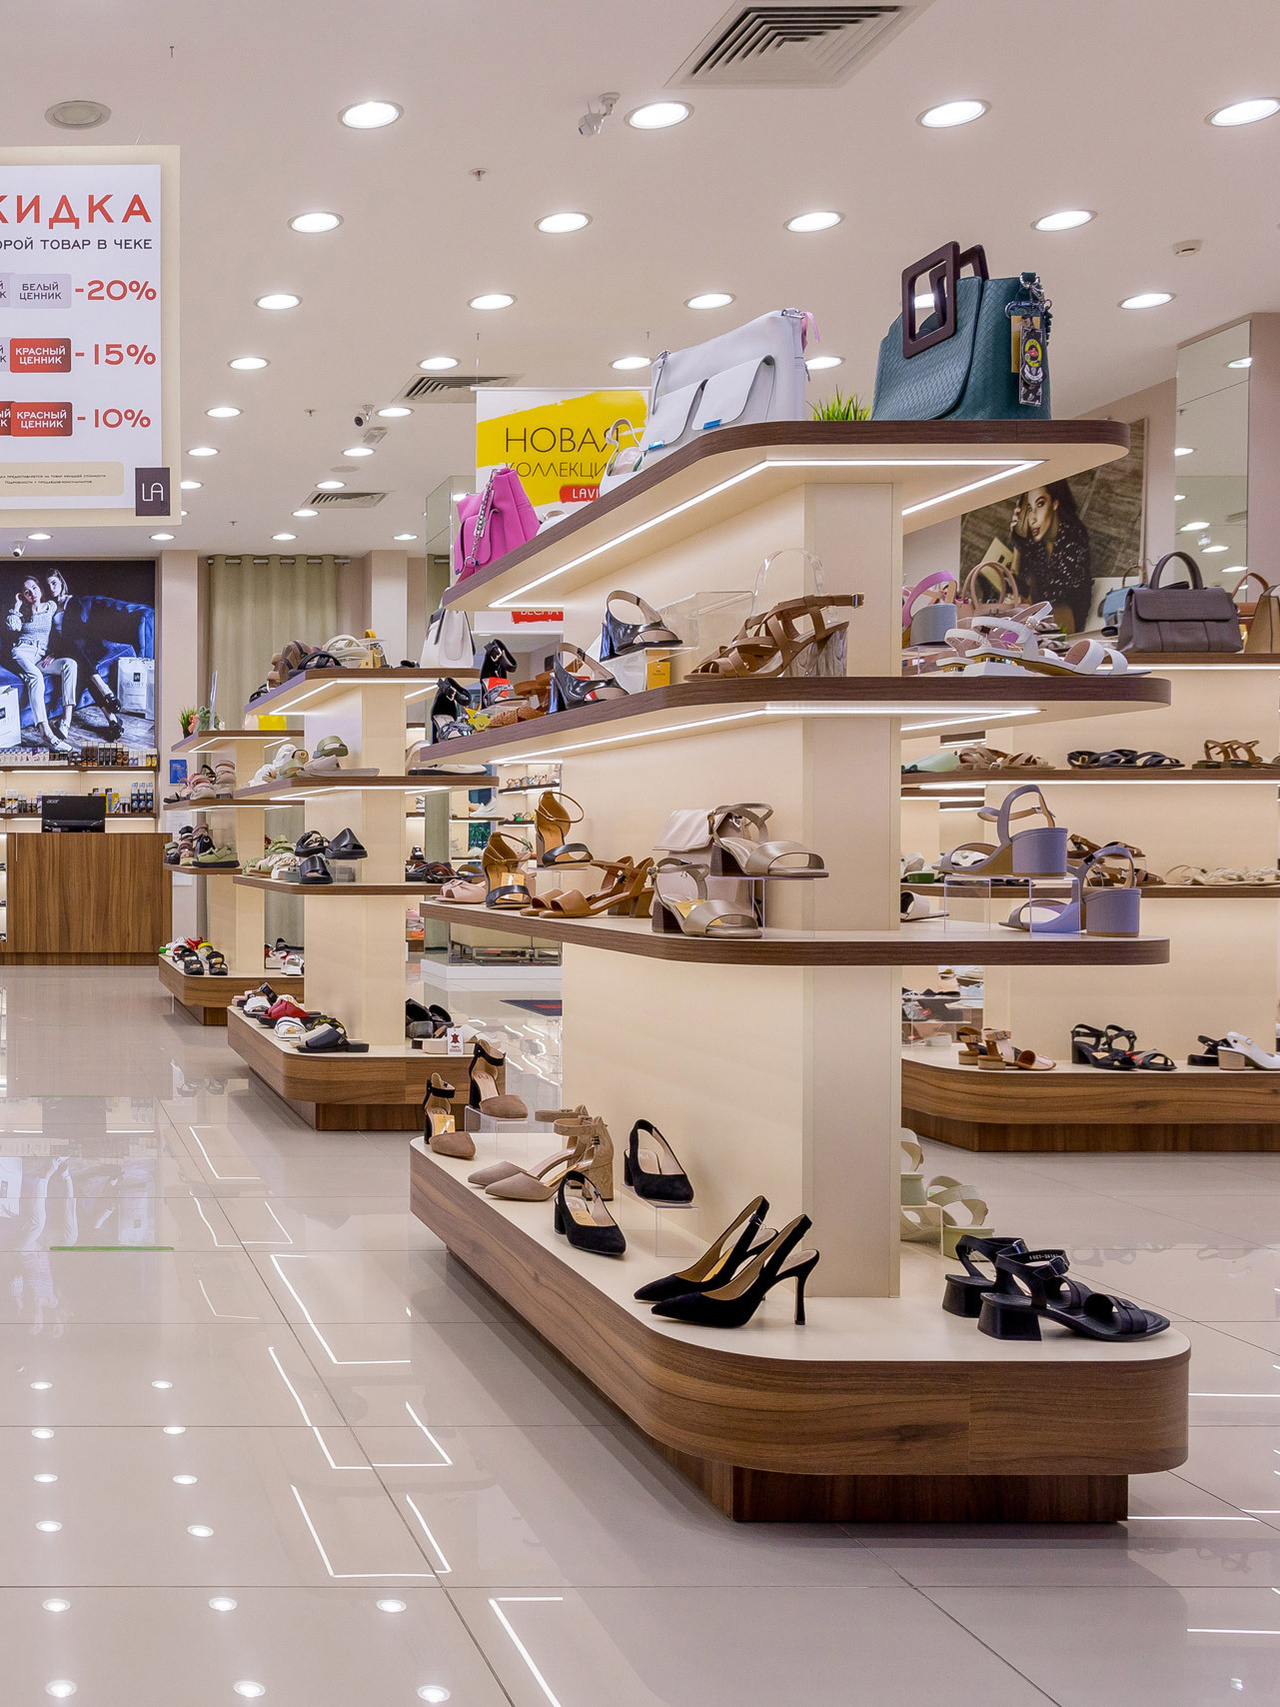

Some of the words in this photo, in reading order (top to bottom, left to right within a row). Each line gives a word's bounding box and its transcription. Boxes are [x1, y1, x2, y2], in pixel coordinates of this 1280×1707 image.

[40, 239, 91, 250] ТОВАР
[97, 239, 108, 250] В
[114, 239, 153, 249] ЧЕКЕ
[22, 281, 59, 291] БЕЛЫЙ
[74, 279, 157, 301] -20%
[19, 292, 62, 301] ЦЕННИК
[15, 345, 66, 356] КРАСНЫЙ
[19, 356, 63, 365] ЦЕННИК
[16, 409, 67, 420] КРАСНЫЙ
[20, 420, 64, 430] ЦЕННИК
[505, 427, 620, 453] НОВАЯ
[505, 462, 608, 479] ОЛЛЕКЦИ
[142, 482, 164, 501] LA
